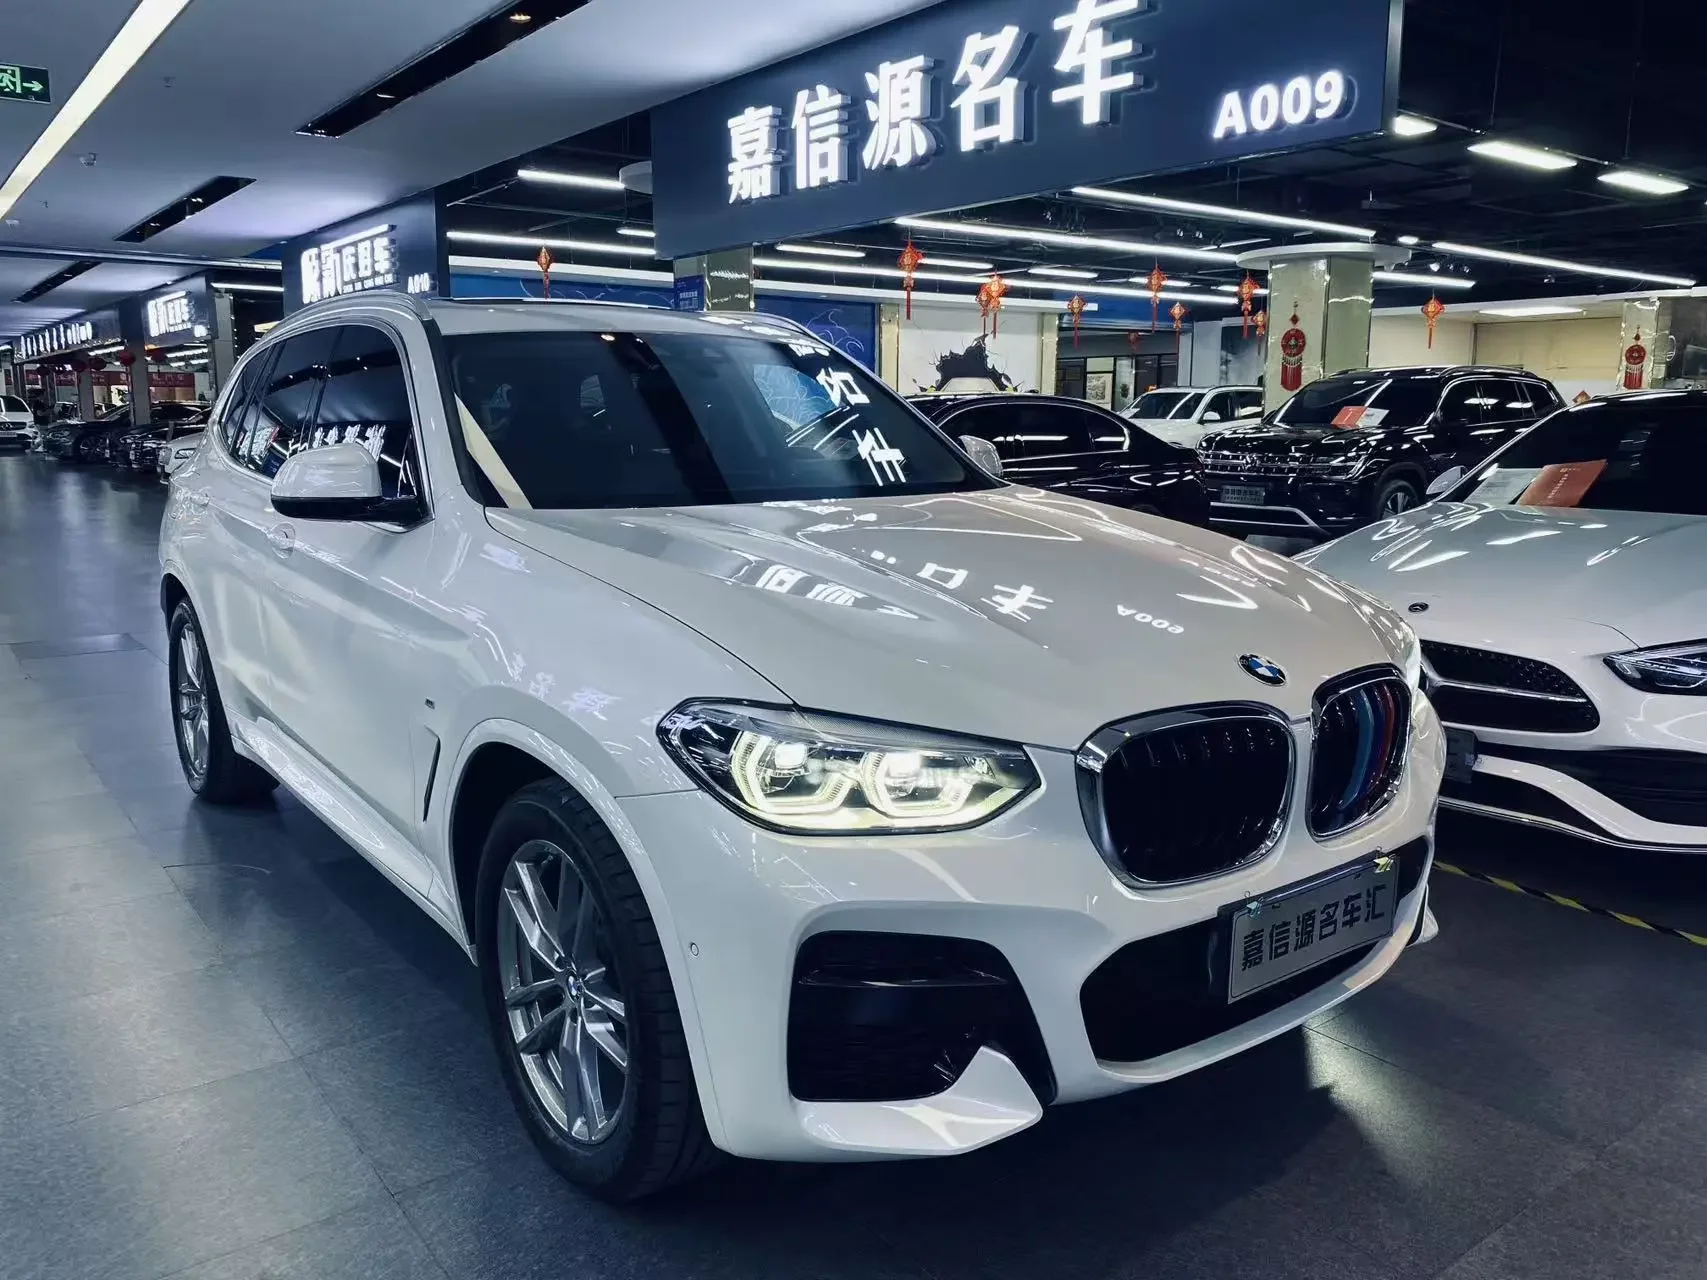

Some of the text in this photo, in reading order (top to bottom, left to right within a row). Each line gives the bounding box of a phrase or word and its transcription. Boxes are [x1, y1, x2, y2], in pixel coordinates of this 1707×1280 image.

[728, 0, 1146, 204] 嘉信源名车
[1212, 70, 1347, 140] A009
[1241, 884, 1387, 971] 嘉信源名车汇
